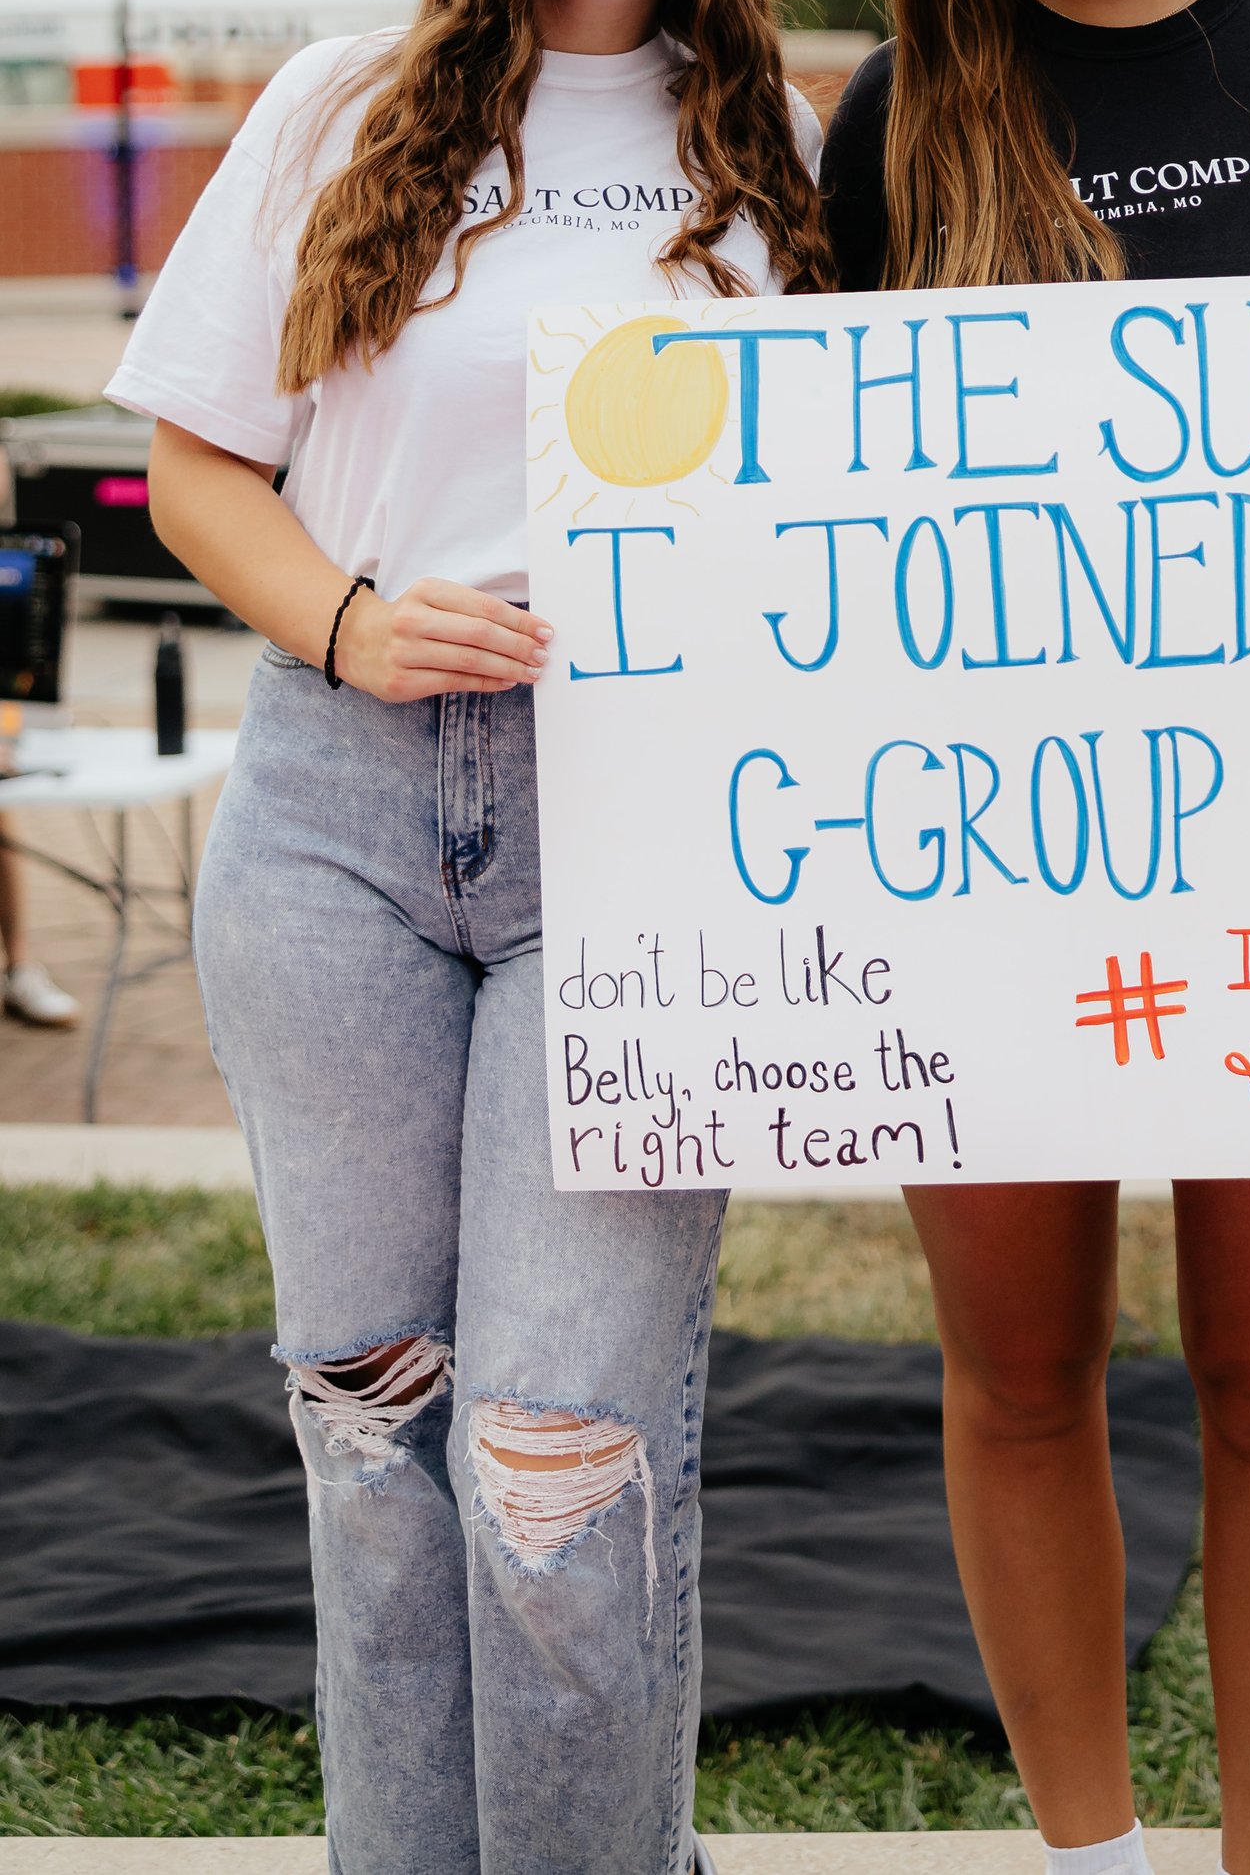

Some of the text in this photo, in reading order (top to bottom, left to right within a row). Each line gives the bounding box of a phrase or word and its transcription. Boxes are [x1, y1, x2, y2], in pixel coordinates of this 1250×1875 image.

[610, 220, 640, 231] MO
[1173, 195, 1202, 209] MO
[652, 311, 1058, 485] THE
[566, 526, 684, 682] I
[559, 925, 892, 1010] don't be like
[564, 1028, 955, 1129] Belly, choose the
[569, 1107, 735, 1188] right
